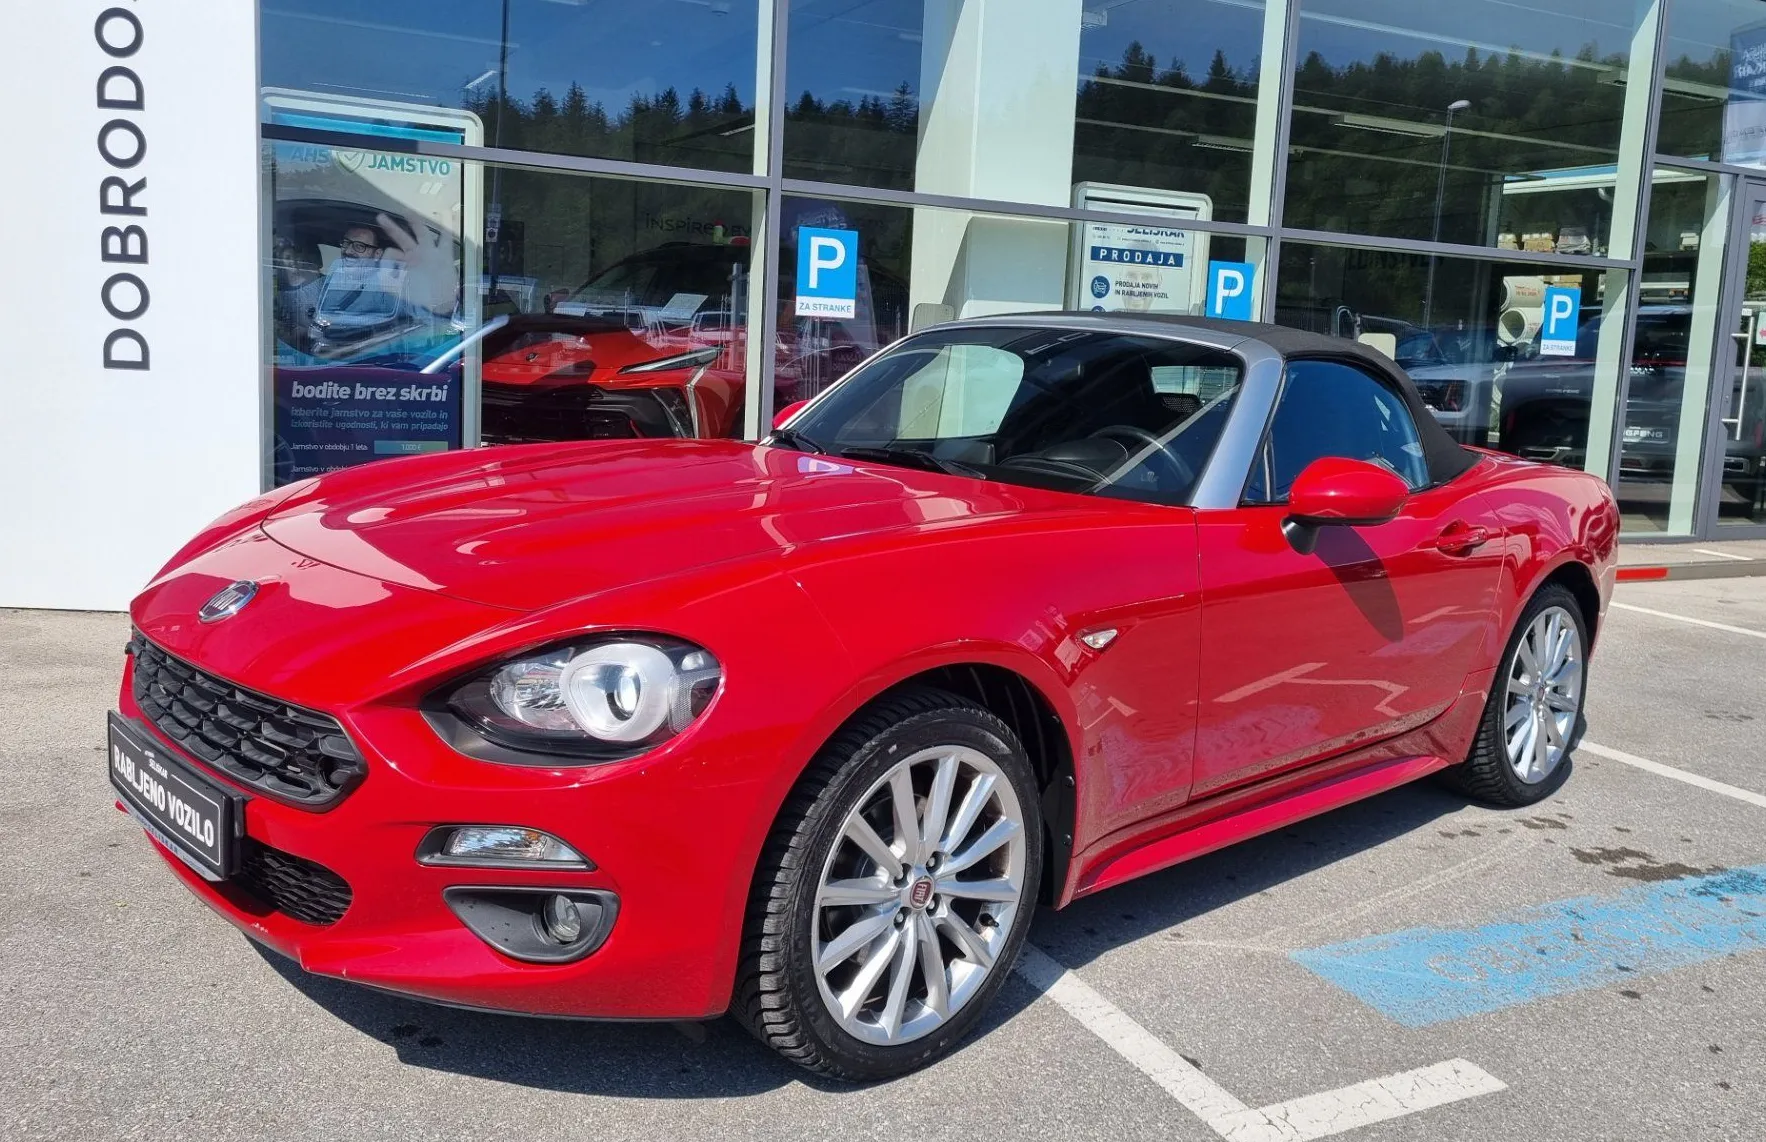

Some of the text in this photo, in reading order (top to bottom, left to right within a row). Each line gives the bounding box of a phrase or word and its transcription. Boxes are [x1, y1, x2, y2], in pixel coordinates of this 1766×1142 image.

[368, 153, 450, 176] JAMSTVO
[94, 0, 151, 372] DOBRODO
[808, 236, 846, 289] P
[1100, 249, 1175, 265] PRODAJA
[1115, 281, 1140, 289] PRODAJA
[1215, 269, 1244, 315] P
[799, 302, 852, 313] ZA STRANKE
[1549, 295, 1573, 334] P
[1542, 343, 1574, 352] ZA STRANKE
[292, 381, 448, 402] bodite brez skrbi
[291, 406, 448, 419] izberite jamstvo za vaše vozilo in
[291, 419, 333, 428] izkoristite
[380, 421, 389, 429] ki
[411, 422, 448, 431] pripadajo
[291, 442, 318, 451] Jamstvo
[324, 442, 350, 452] obdobju
[355, 443, 368, 451] leta
[291, 465, 318, 473] Jamstvo
[114, 744, 214, 848] RABLJENO VOZILO
